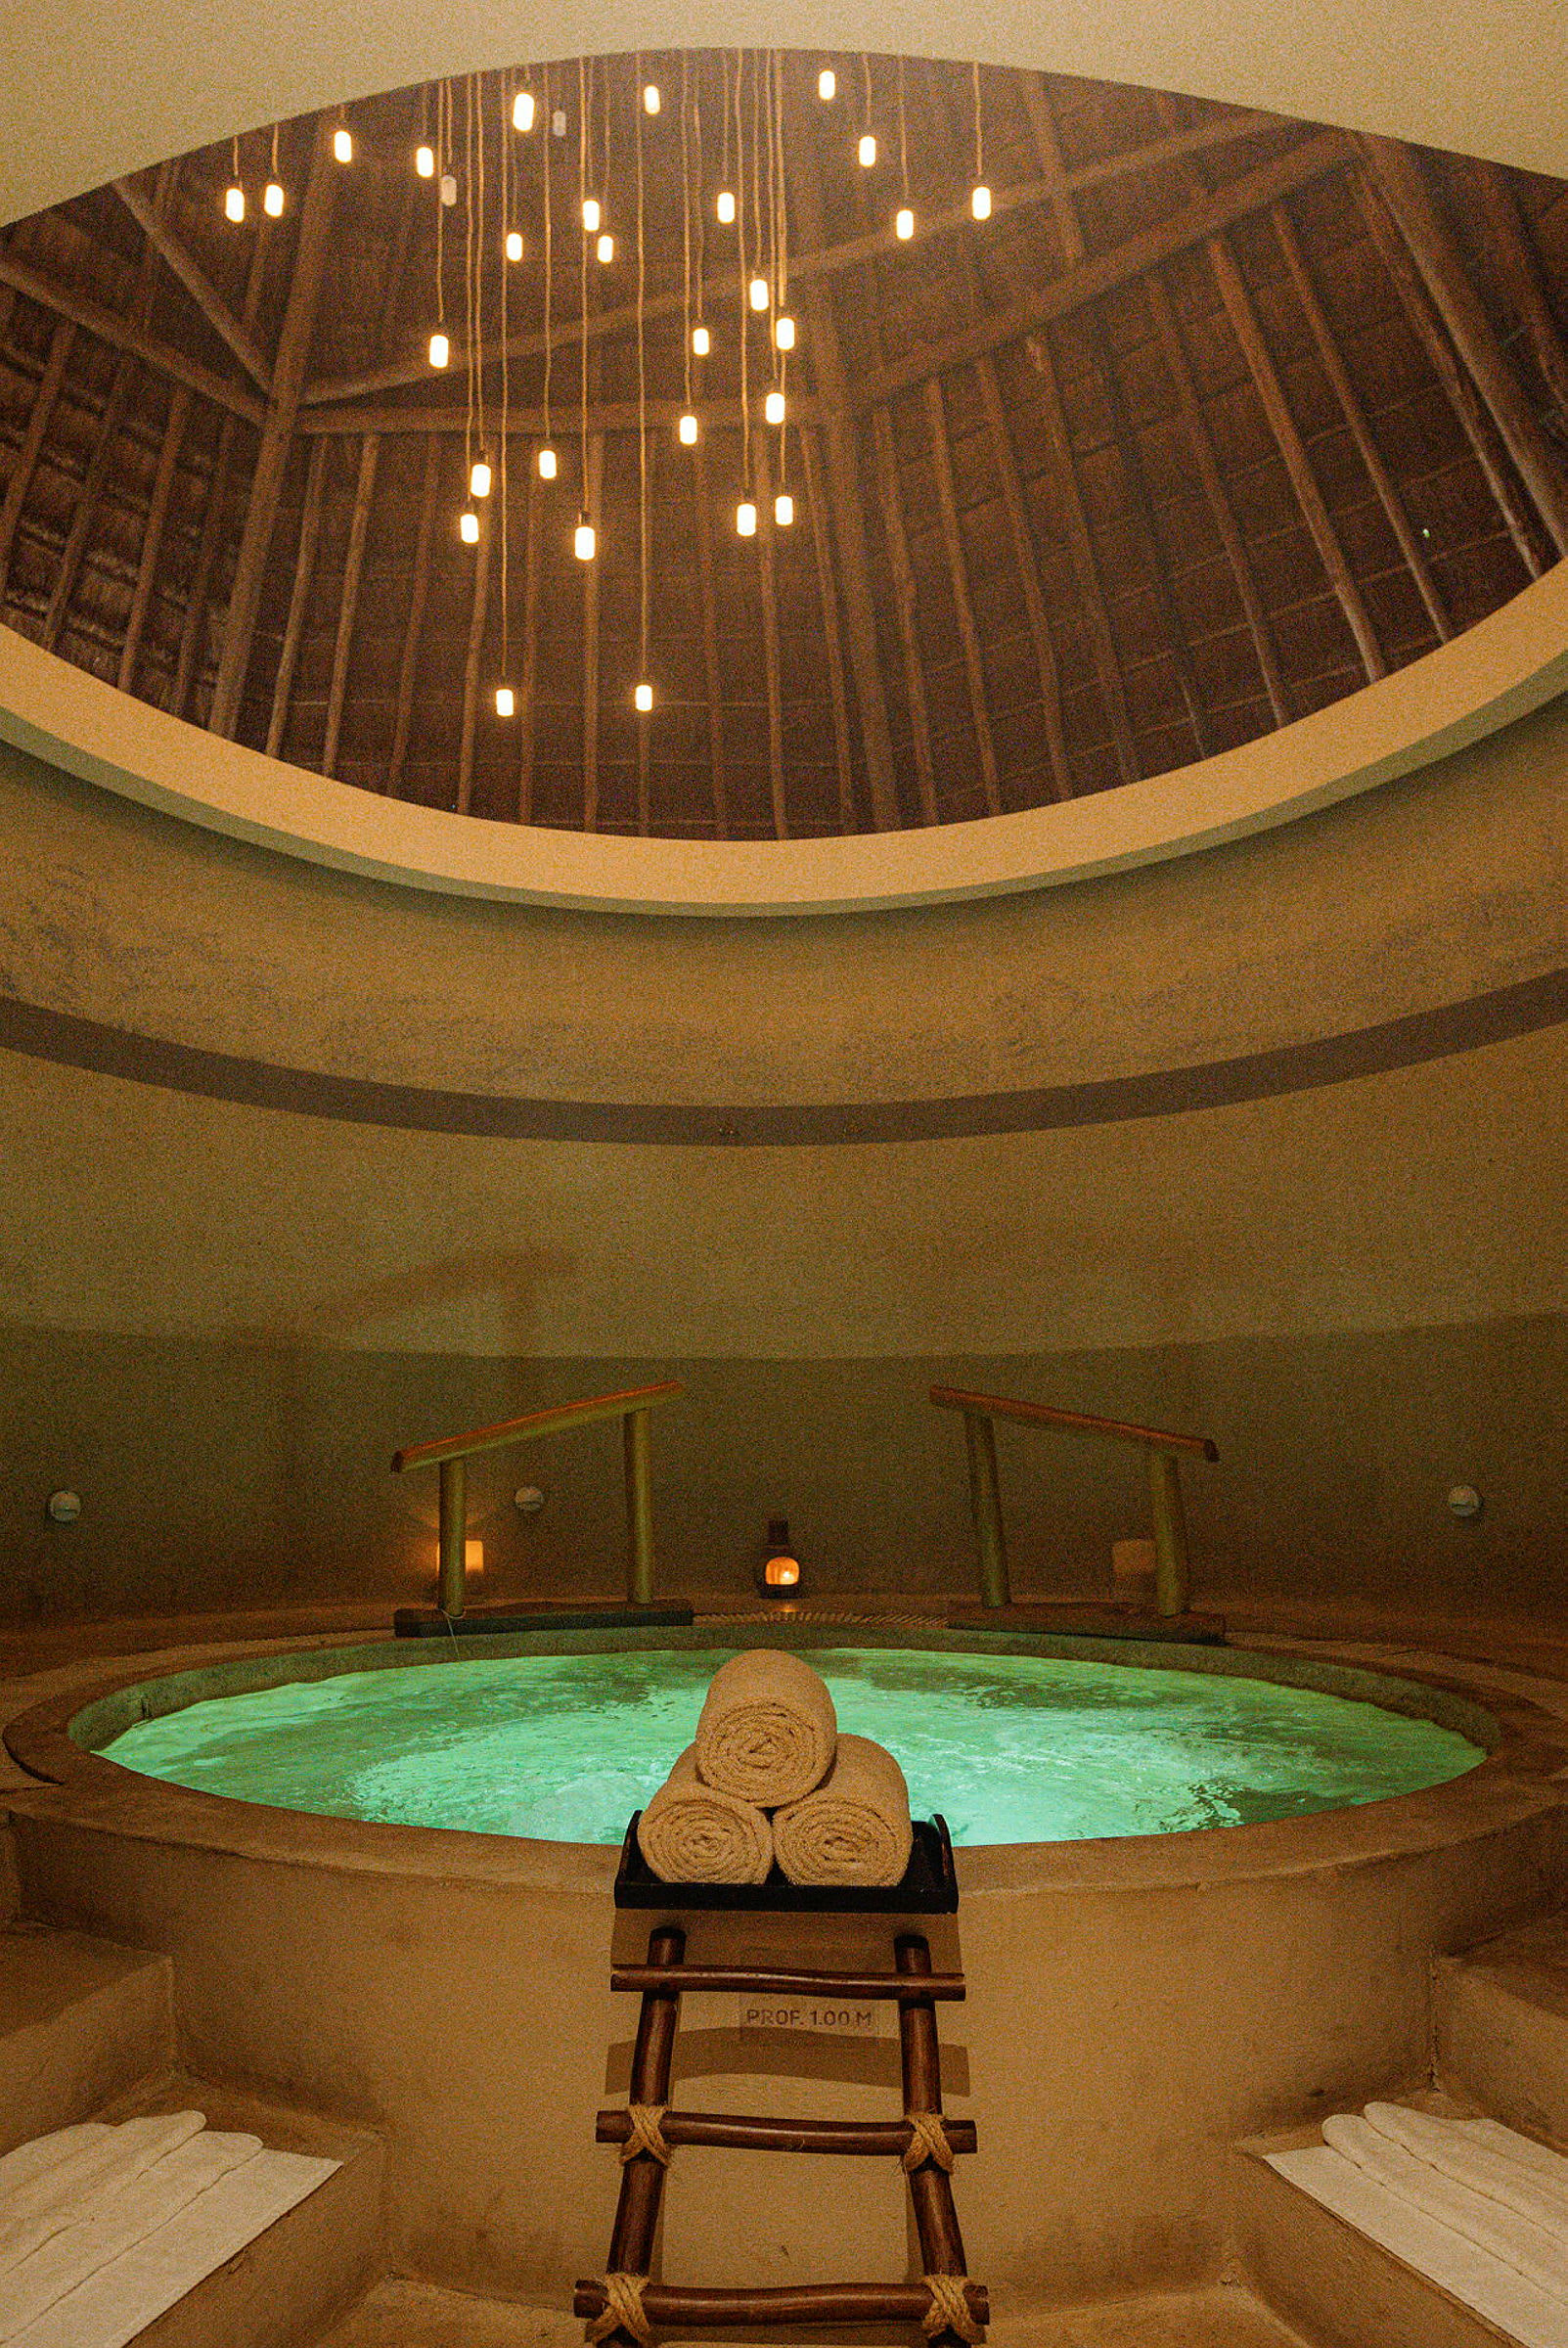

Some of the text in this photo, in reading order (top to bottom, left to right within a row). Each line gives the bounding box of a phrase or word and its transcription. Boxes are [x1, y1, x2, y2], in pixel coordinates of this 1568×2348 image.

[746, 2009, 873, 2027] PROF. 1.00 M
